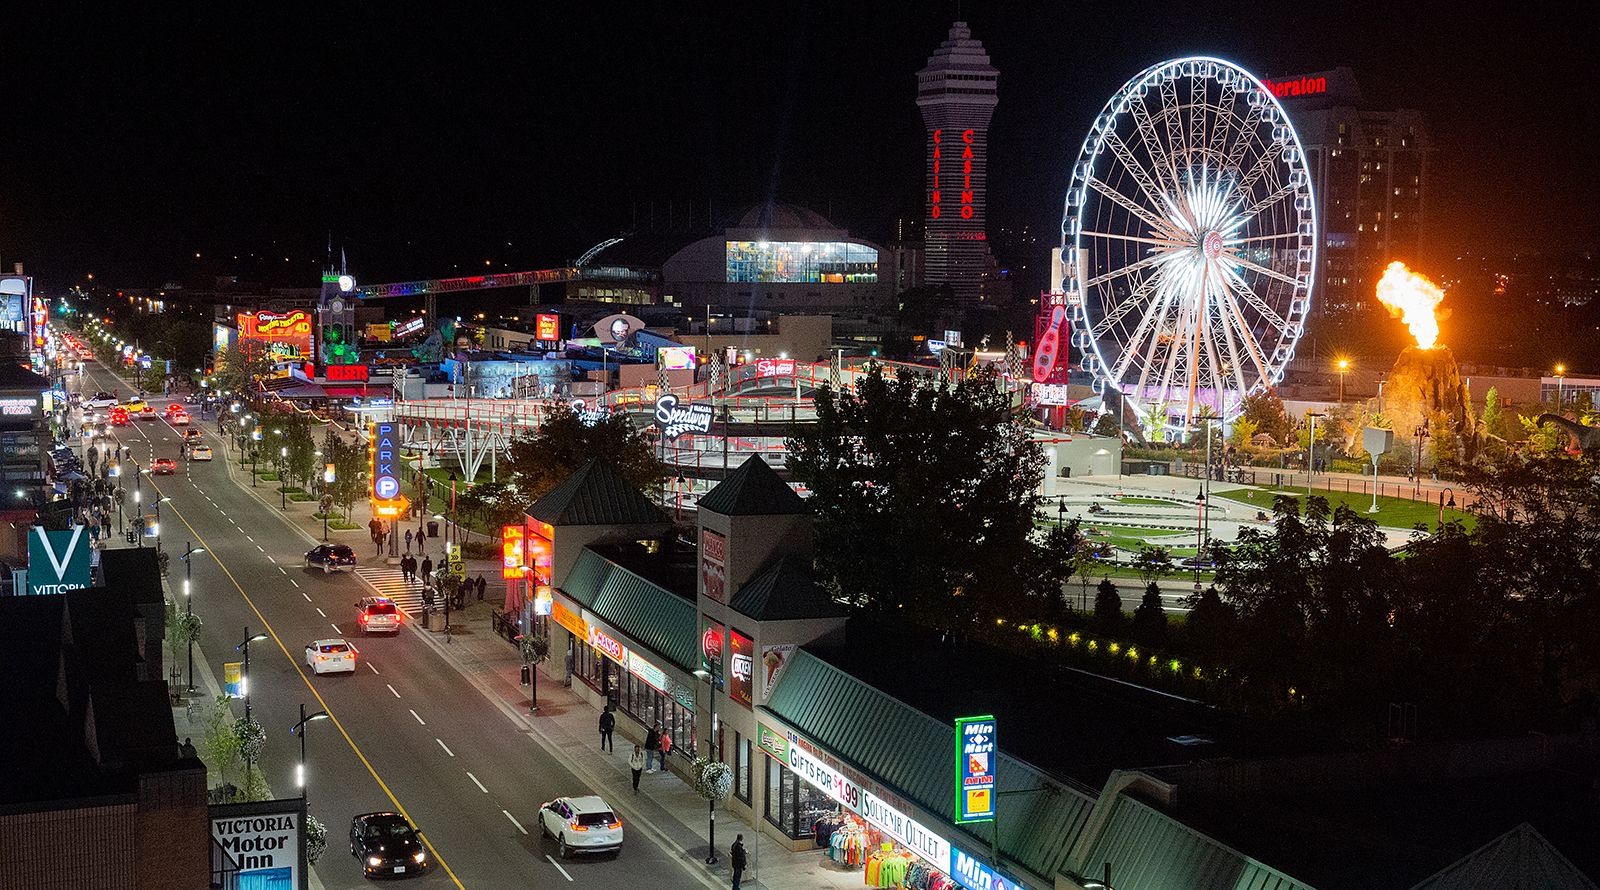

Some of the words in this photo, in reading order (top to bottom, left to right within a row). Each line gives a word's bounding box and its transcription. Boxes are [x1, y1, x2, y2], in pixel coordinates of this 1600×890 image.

[932, 129, 941, 219] CASINO
[961, 129, 974, 219] CASINO
[295, 322, 309, 333] 4D
[327, 365, 369, 382] KELSEYS
[3, 406, 31, 414] PIZZA
[656, 395, 712, 432] Speedway
[380, 425, 393, 474] PARK
[380, 481, 395, 495] P
[35, 525, 85, 582] V
[596, 631, 621, 658] MANGO
[965, 724, 993, 735] Min
[965, 742, 993, 753] Mart
[790, 748, 815, 778] GIFTS
[816, 770, 833, 791] FOR
[833, 774, 859, 809] $1.99
[965, 775, 993, 785] ATM
[216, 816, 295, 835] VICTORIA
[863, 793, 903, 836] SOUVENIR
[905, 820, 939, 860] OUTLET
[222, 834, 289, 853] Motor
[237, 853, 273, 870] Inn
[956, 851, 992, 890] Min
